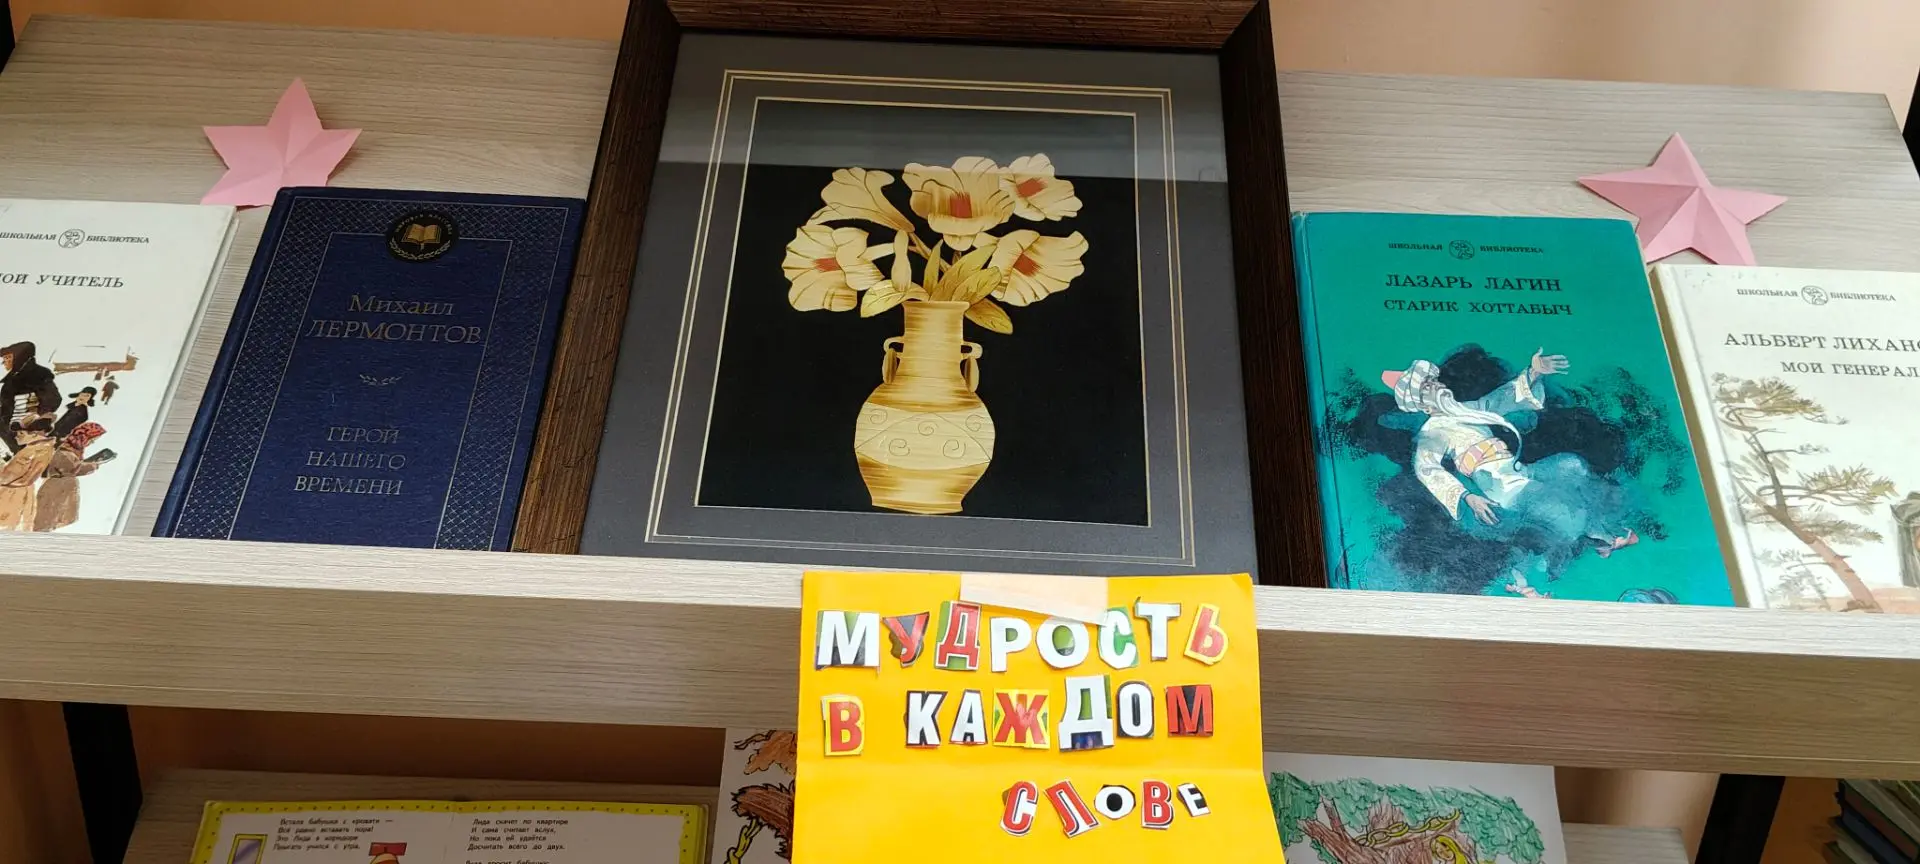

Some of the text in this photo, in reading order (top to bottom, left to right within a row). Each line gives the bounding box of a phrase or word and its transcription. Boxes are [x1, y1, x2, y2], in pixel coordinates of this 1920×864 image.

[0, 232, 150, 244] ШКОЛЬНАЯ БИБЛИОТЕКА
[1388, 243, 1544, 254] ШКОЛЬНАЯ БИБЛИОТЕКА
[0, 272, 124, 288] ОЙ УЧИТЕЛЬ
[1385, 274, 1562, 292] ЛАЗАРЬ ЛАГИН
[1737, 288, 1896, 302] ШКОЛЬНАЯ БИБЛИОТЕКА
[348, 294, 455, 316] Михаил
[1384, 299, 1573, 316] СТАРИК ХОТТАБЫЧ
[305, 320, 482, 344] ЛЕРМОНТОВ
[1724, 333, 1827, 349] АЛЬБЕРТ
[1832, 363, 1920, 378] ГЕНЕРАЛ
[305, 450, 407, 470] НАШЕГО
[293, 475, 404, 495] ВРЕМЕНИ
[815, 599, 1229, 672] МУДРОСТЬ
[825, 674, 1214, 755] В КАЖДОМ
[1000, 778, 1211, 838] СЛОВЕ
[467, 843, 503, 851] Досчитать
